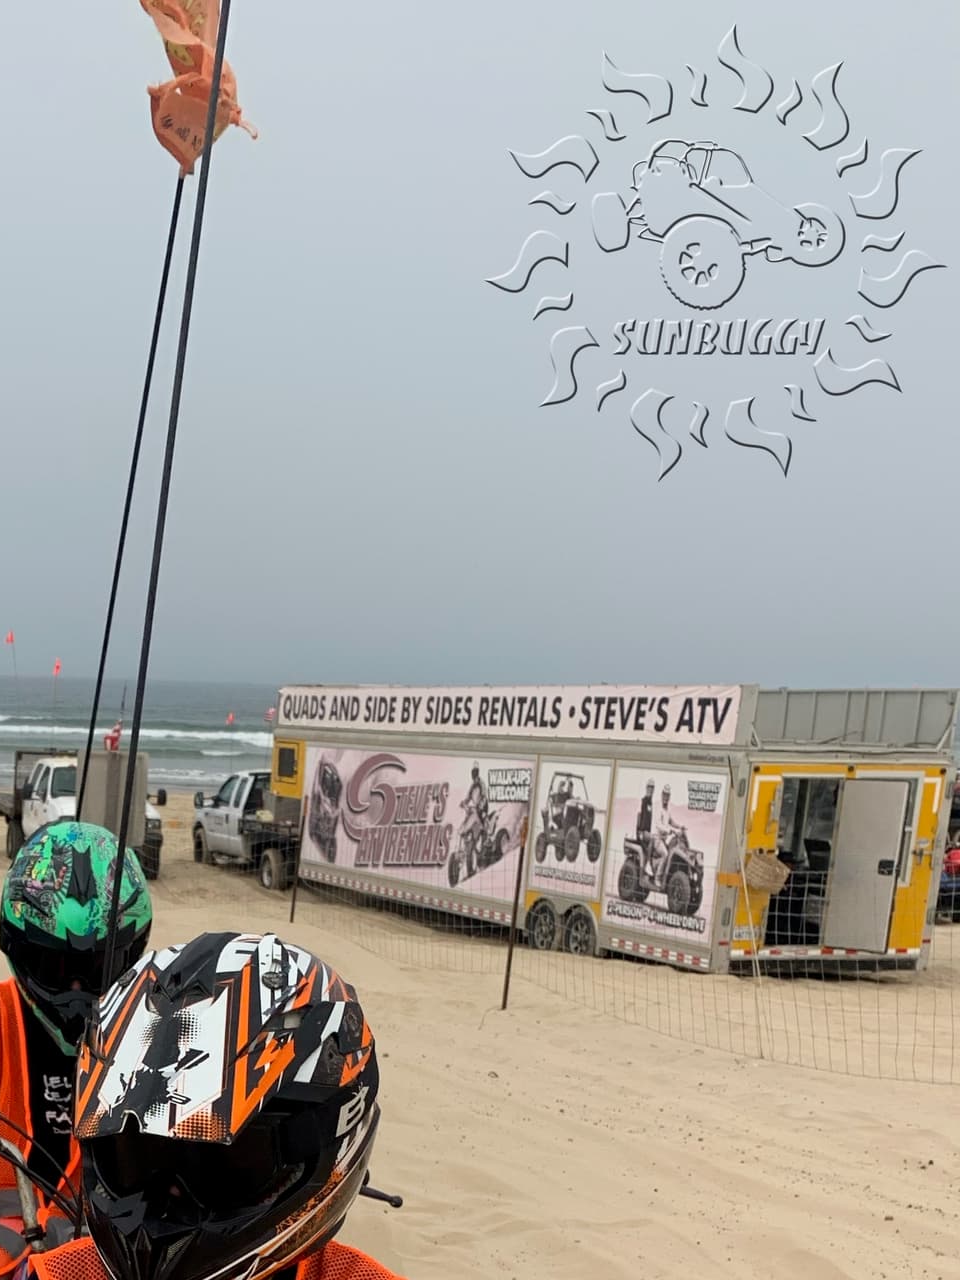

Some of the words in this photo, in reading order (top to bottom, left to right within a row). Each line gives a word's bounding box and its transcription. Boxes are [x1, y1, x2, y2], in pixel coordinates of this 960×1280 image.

[283, 695, 326, 720] QUADS
[329, 696, 360, 722] AND
[364, 696, 396, 723] SIDE
[400, 696, 422, 724] BY
[425, 696, 472, 726] SIDES
[477, 696, 562, 729] RENTALS
[578, 696, 669, 732] STEVE'S
[675, 698, 733, 734] ATV
[489, 769, 531, 786] WALK-UPS
[489, 786, 530, 802] WELCOME
[355, 829, 384, 867] ATV
[384, 824, 453, 867] RENTALS
